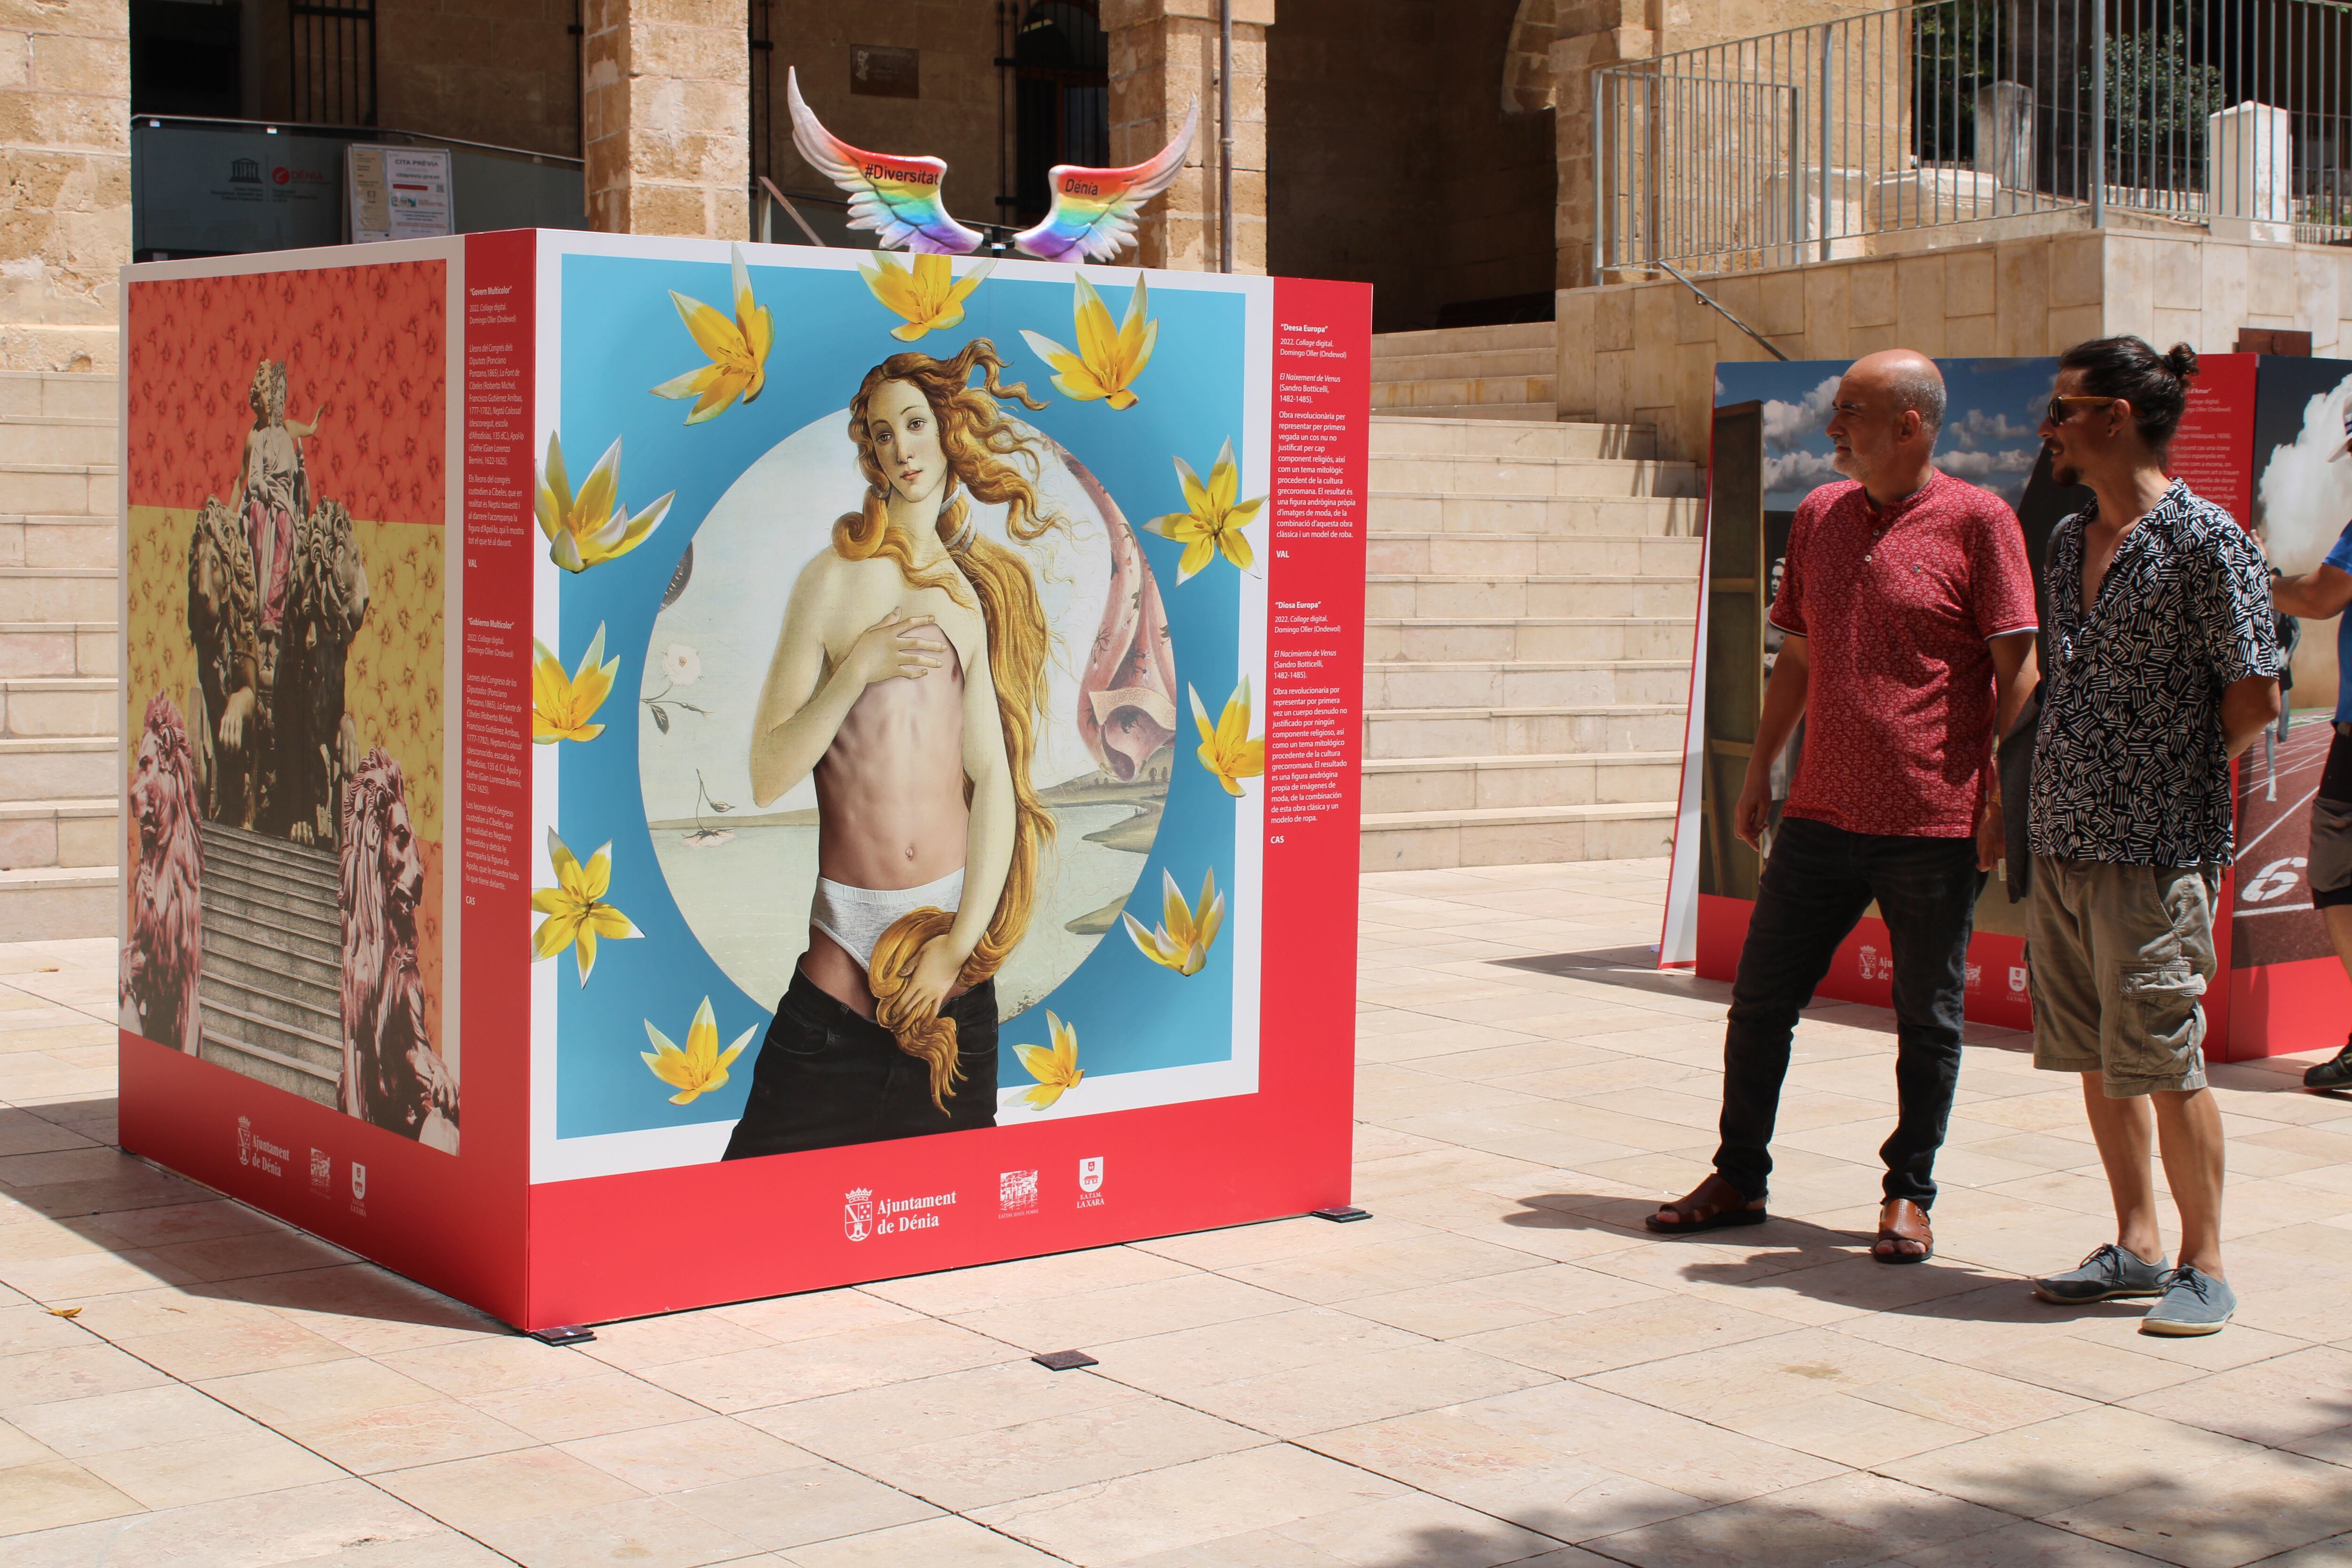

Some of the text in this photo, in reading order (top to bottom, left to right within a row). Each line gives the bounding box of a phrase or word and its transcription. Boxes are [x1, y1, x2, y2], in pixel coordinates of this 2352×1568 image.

[865, 164, 938, 185] #Diversitat
[1065, 178, 1098, 195] Dénia
[1295, 338, 1315, 348] Collage
[1315, 339, 1334, 349] digital.
[1280, 348, 1305, 358] Domingo
[1319, 350, 1347, 359] (Ondewol)
[1285, 373, 1316, 382] Naixement
[1279, 383, 1329, 394] (Sandro Botticelli,
[1280, 395, 1313, 404] 1482-1485).
[1295, 411, 1335, 420] revolucionària
[1323, 423, 1346, 432] primera
[1278, 432, 1300, 442] vegada
[1278, 443, 1303, 453] justificat
[1312, 455, 1335, 464] religiós,
[1316, 466, 1343, 476] mitològic
[1278, 476, 1308, 485] procedent
[1289, 497, 1306, 507] figura
[1307, 498, 1336, 508] andrògina
[1337, 499, 1356, 508] pròpia
[1314, 509, 1333, 517] moda,
[468, 558, 477, 568] VAL
[1290, 615, 1310, 624] Collage
[1310, 615, 1328, 624] digital.
[1274, 626, 1300, 635] Domingo
[1314, 625, 1341, 633] (Ondewol)
[1274, 660, 1323, 669] (Sandro Botticelli,
[1274, 671, 1307, 679] 1482-1485).
[1288, 686, 1329, 695] revolucionaria
[1273, 699, 1306, 708] representar
[1318, 697, 1340, 706] primera
[1314, 707, 1339, 715] desnudo
[1272, 719, 1303, 729] justificado
[1314, 718, 1335, 727] ningún
[1272, 730, 1310, 739] componente
[1310, 729, 1335, 738] religioso,
[1314, 739, 1345, 748] mitológico
[1271, 835, 1284, 844] CAS
[2241, 857, 2308, 902] 6
[466, 895, 475, 906] CAS
[252, 1134, 289, 1161] Ajuntament
[253, 1153, 281, 1177] de Dénia
[877, 1191, 956, 1218] Ajuntament
[1086, 1198, 1105, 1207] XARA
[877, 1213, 939, 1235] de Dénia
